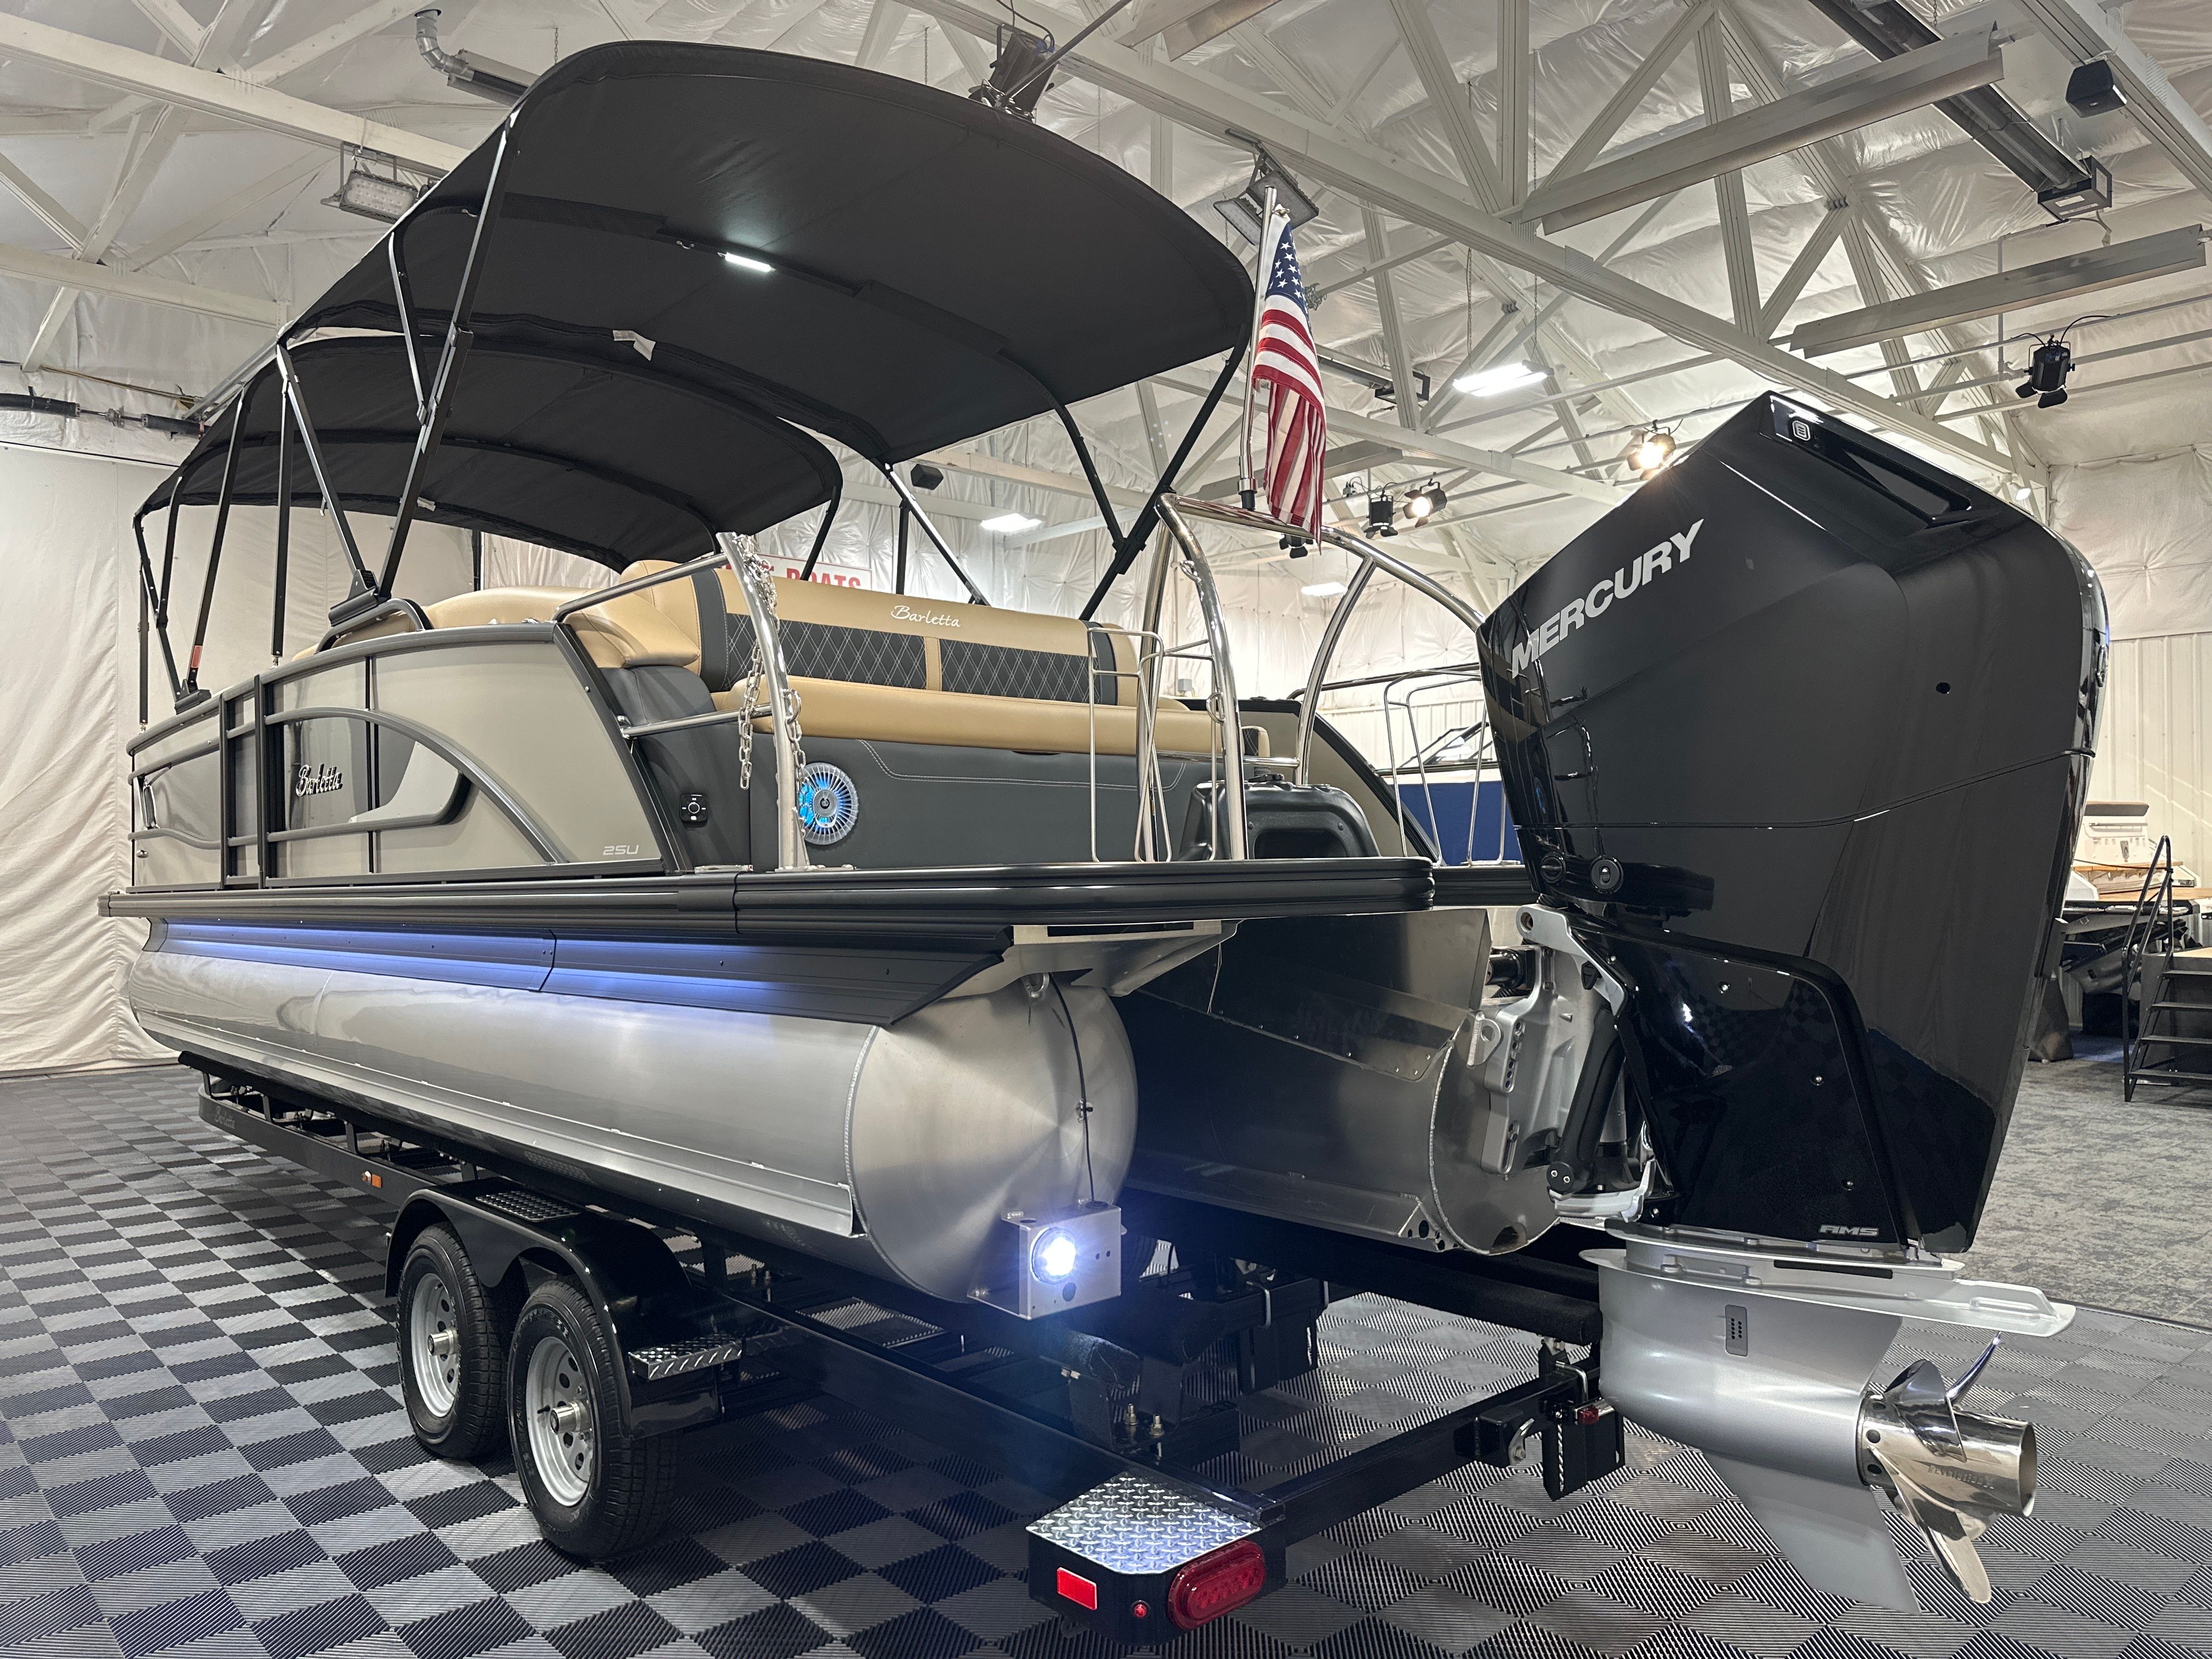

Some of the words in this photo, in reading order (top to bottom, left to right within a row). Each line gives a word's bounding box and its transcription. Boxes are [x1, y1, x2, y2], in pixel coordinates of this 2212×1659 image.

[1513, 519, 1704, 679] MERCURY
[891, 606, 961, 628] Barletta
[296, 763, 343, 797] Barletta
[1819, 1224, 1879, 1236] AMS
